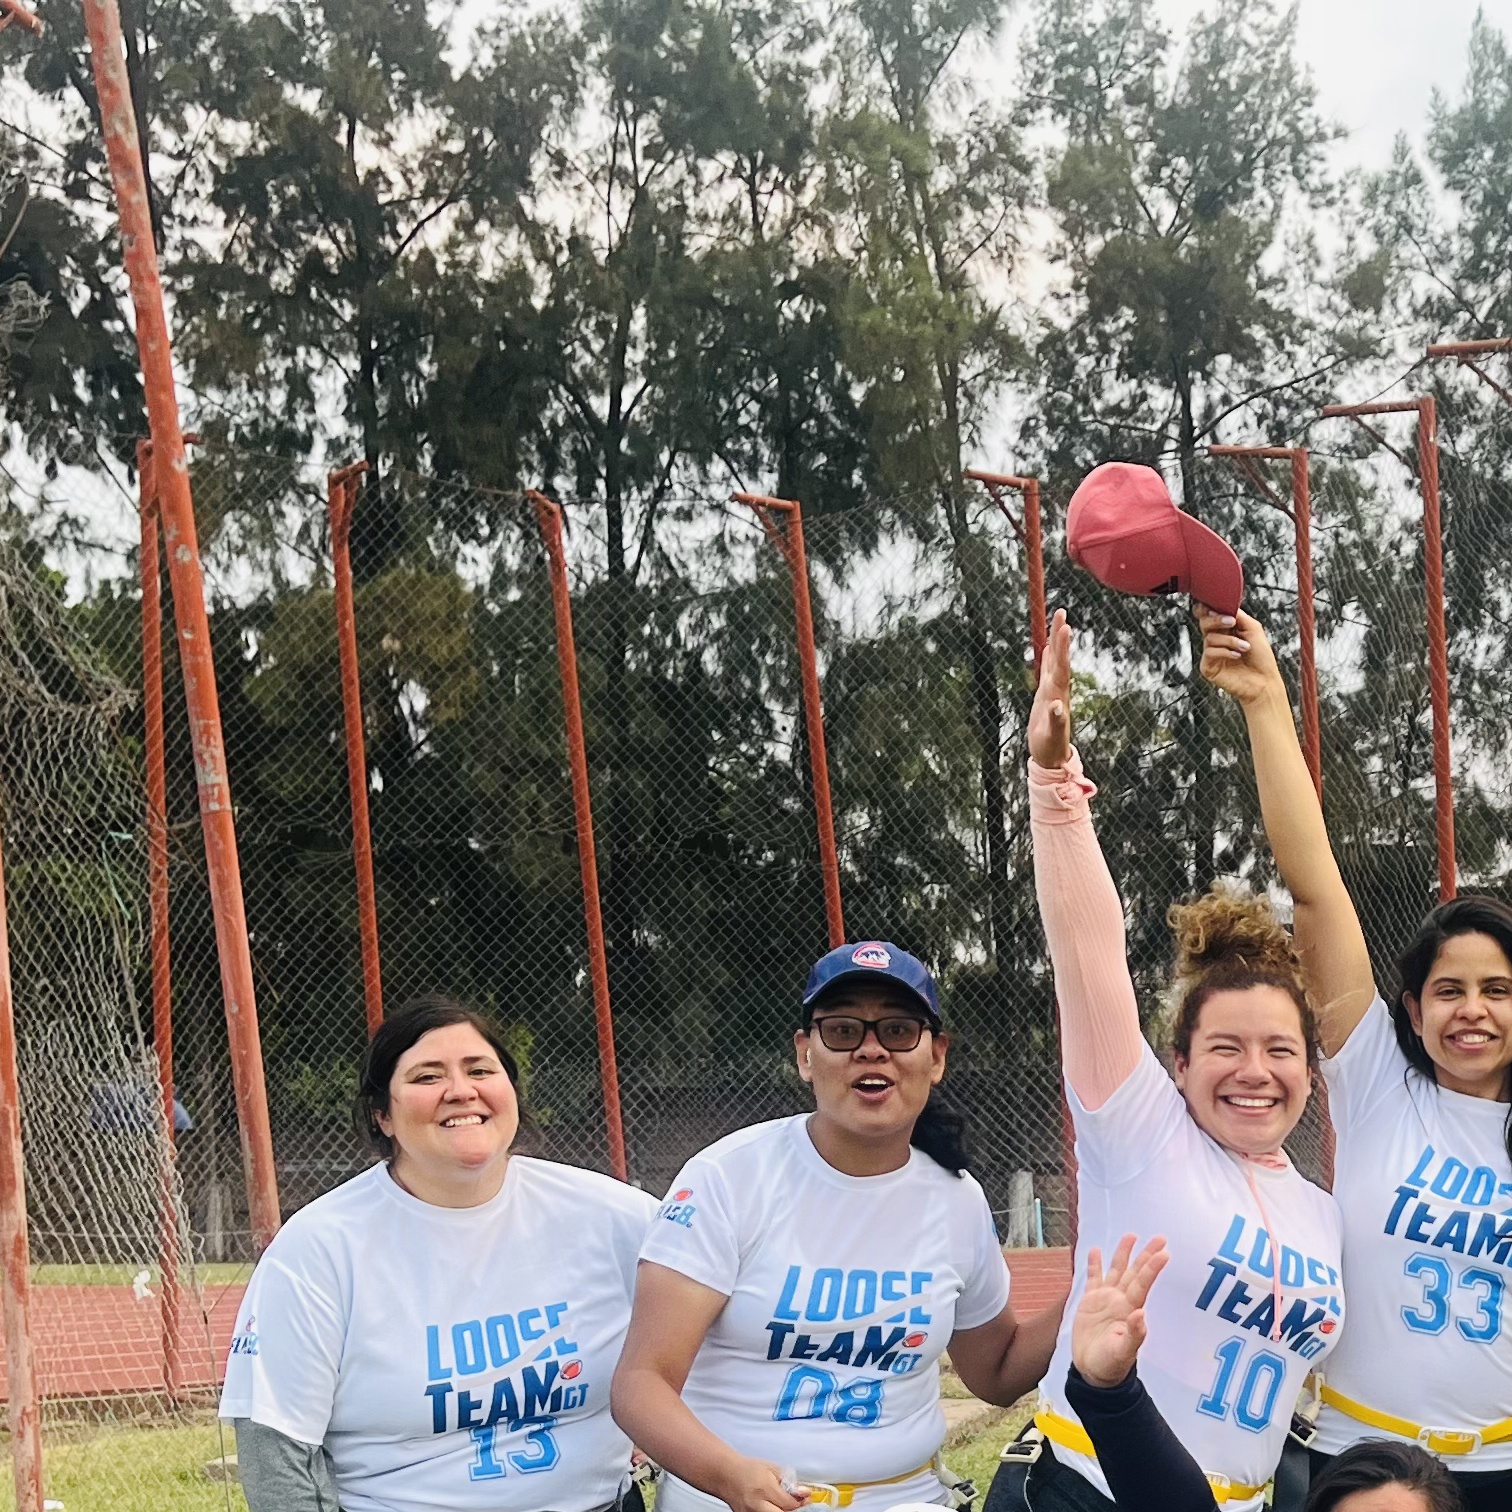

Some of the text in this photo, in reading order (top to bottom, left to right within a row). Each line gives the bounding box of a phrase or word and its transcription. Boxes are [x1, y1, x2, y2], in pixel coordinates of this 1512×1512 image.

[773, 1265, 933, 1324] LOOSE
[1217, 1214, 1341, 1316] LOOSE
[1401, 1252, 1506, 1345] 33
[426, 1302, 578, 1381] LOOSE
[1195, 1257, 1326, 1352] TEAM
[765, 1321, 907, 1371] TEAM
[424, 1360, 562, 1434] TEAM
[773, 1363, 885, 1428] 08
[1196, 1335, 1287, 1434] 10
[468, 1415, 561, 1481] 13
